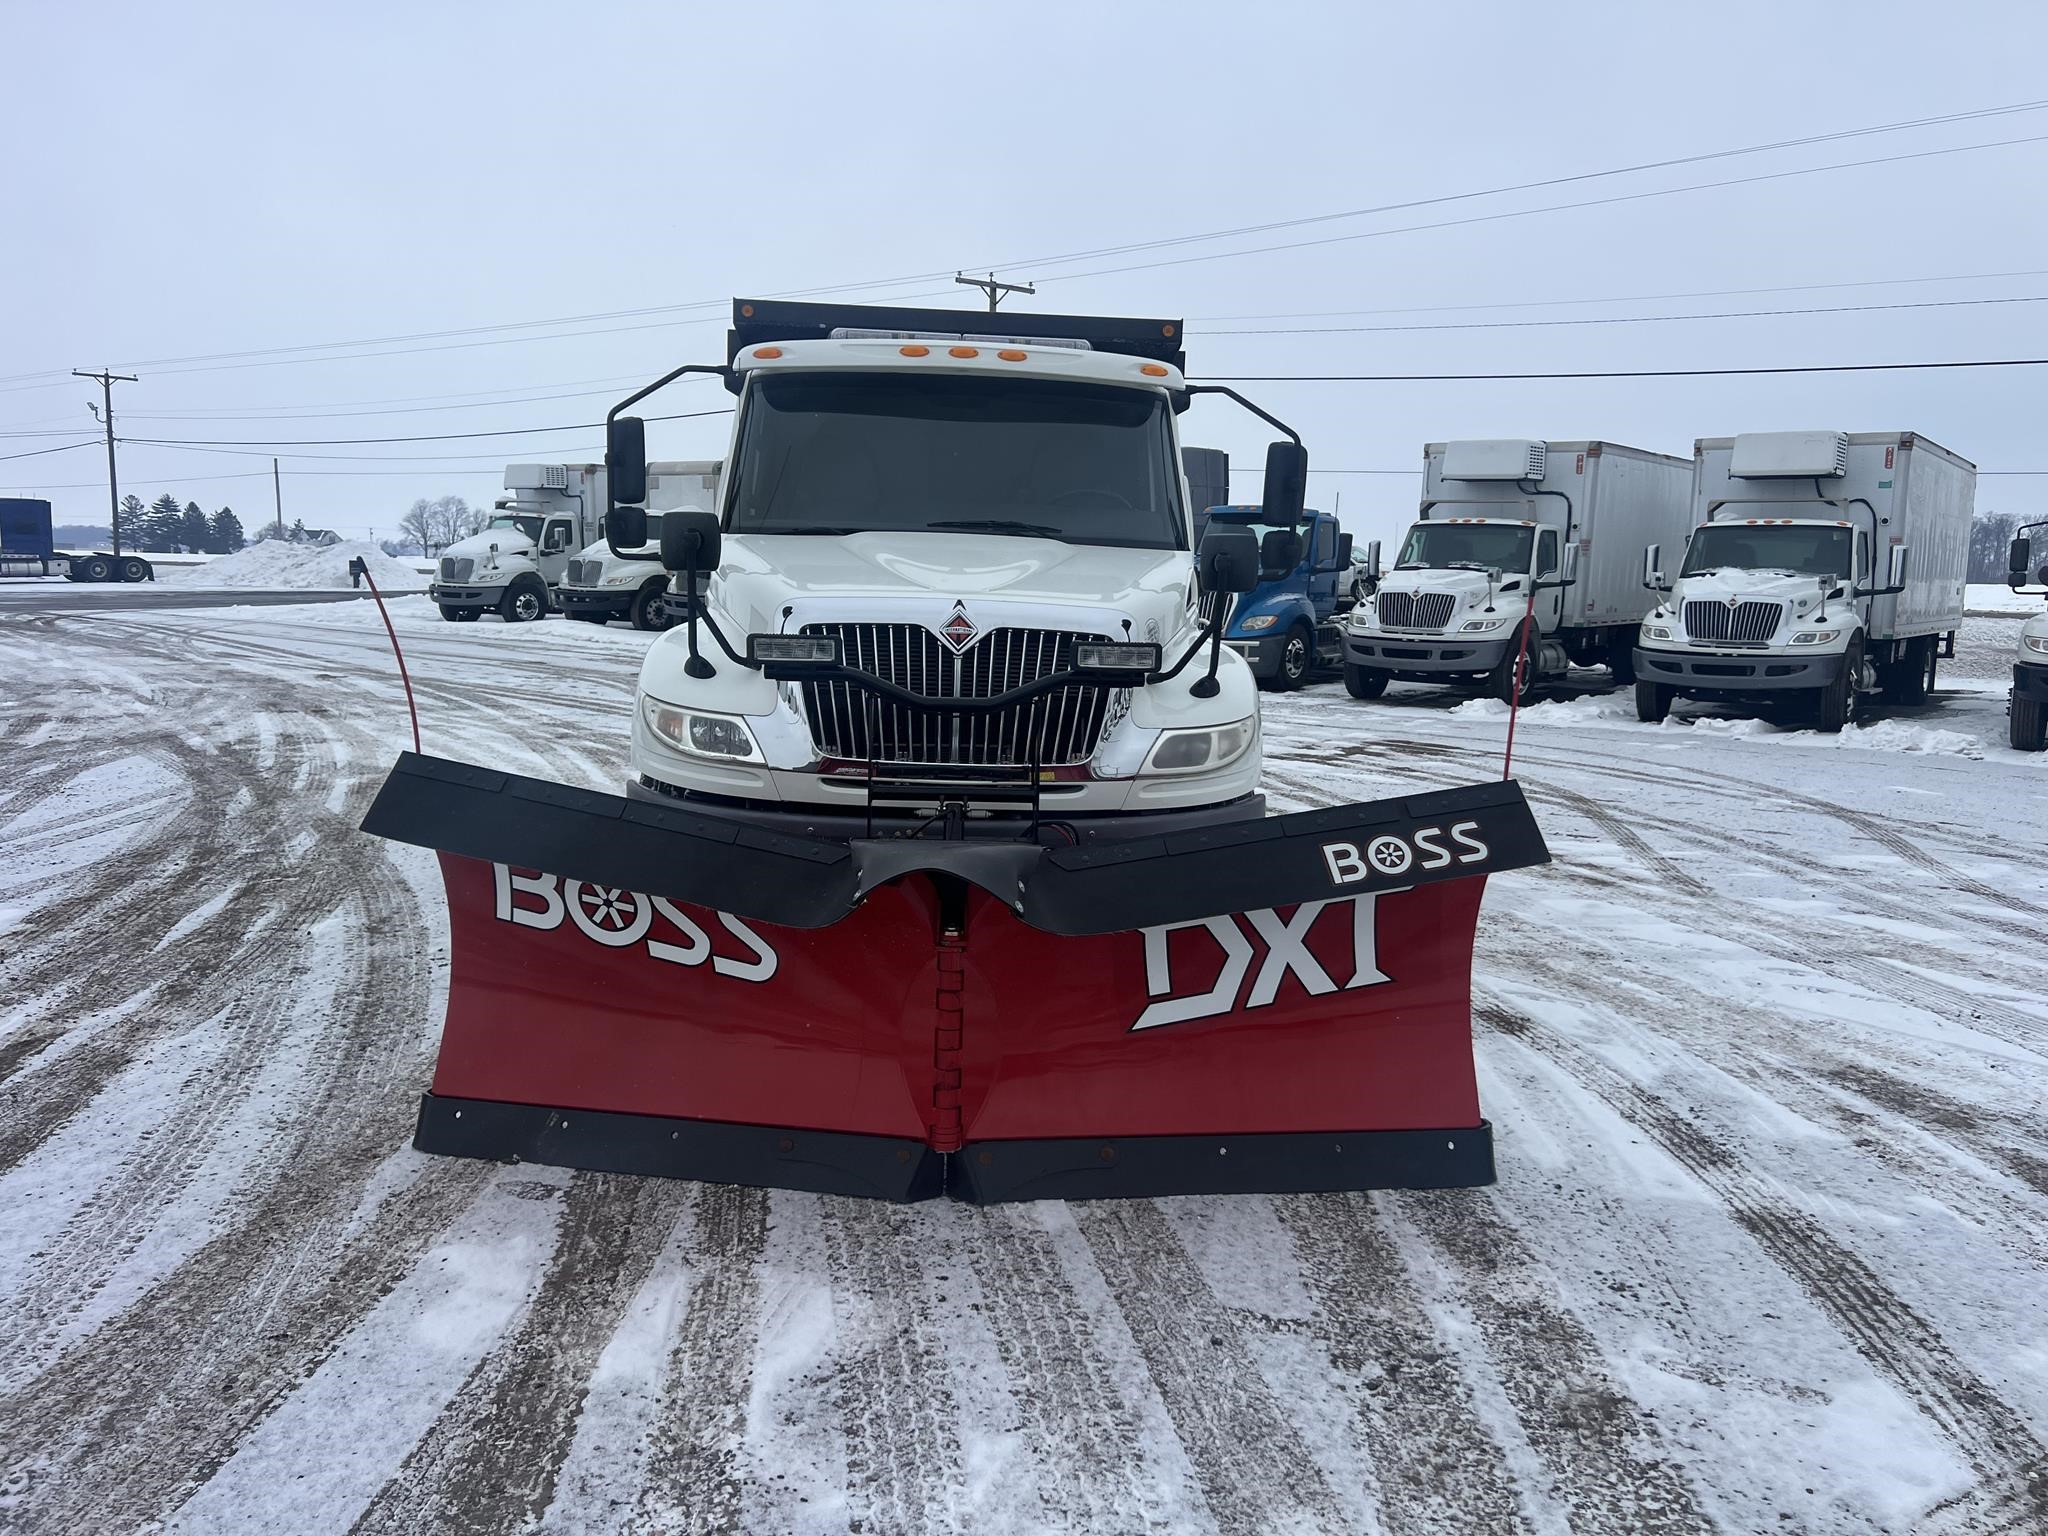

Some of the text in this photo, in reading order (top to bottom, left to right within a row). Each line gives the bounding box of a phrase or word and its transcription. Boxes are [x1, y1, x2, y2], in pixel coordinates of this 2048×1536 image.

[1322, 821, 1488, 885] BOSS
[493, 863, 778, 982] BOSS
[1129, 885, 1416, 1031] DXT
